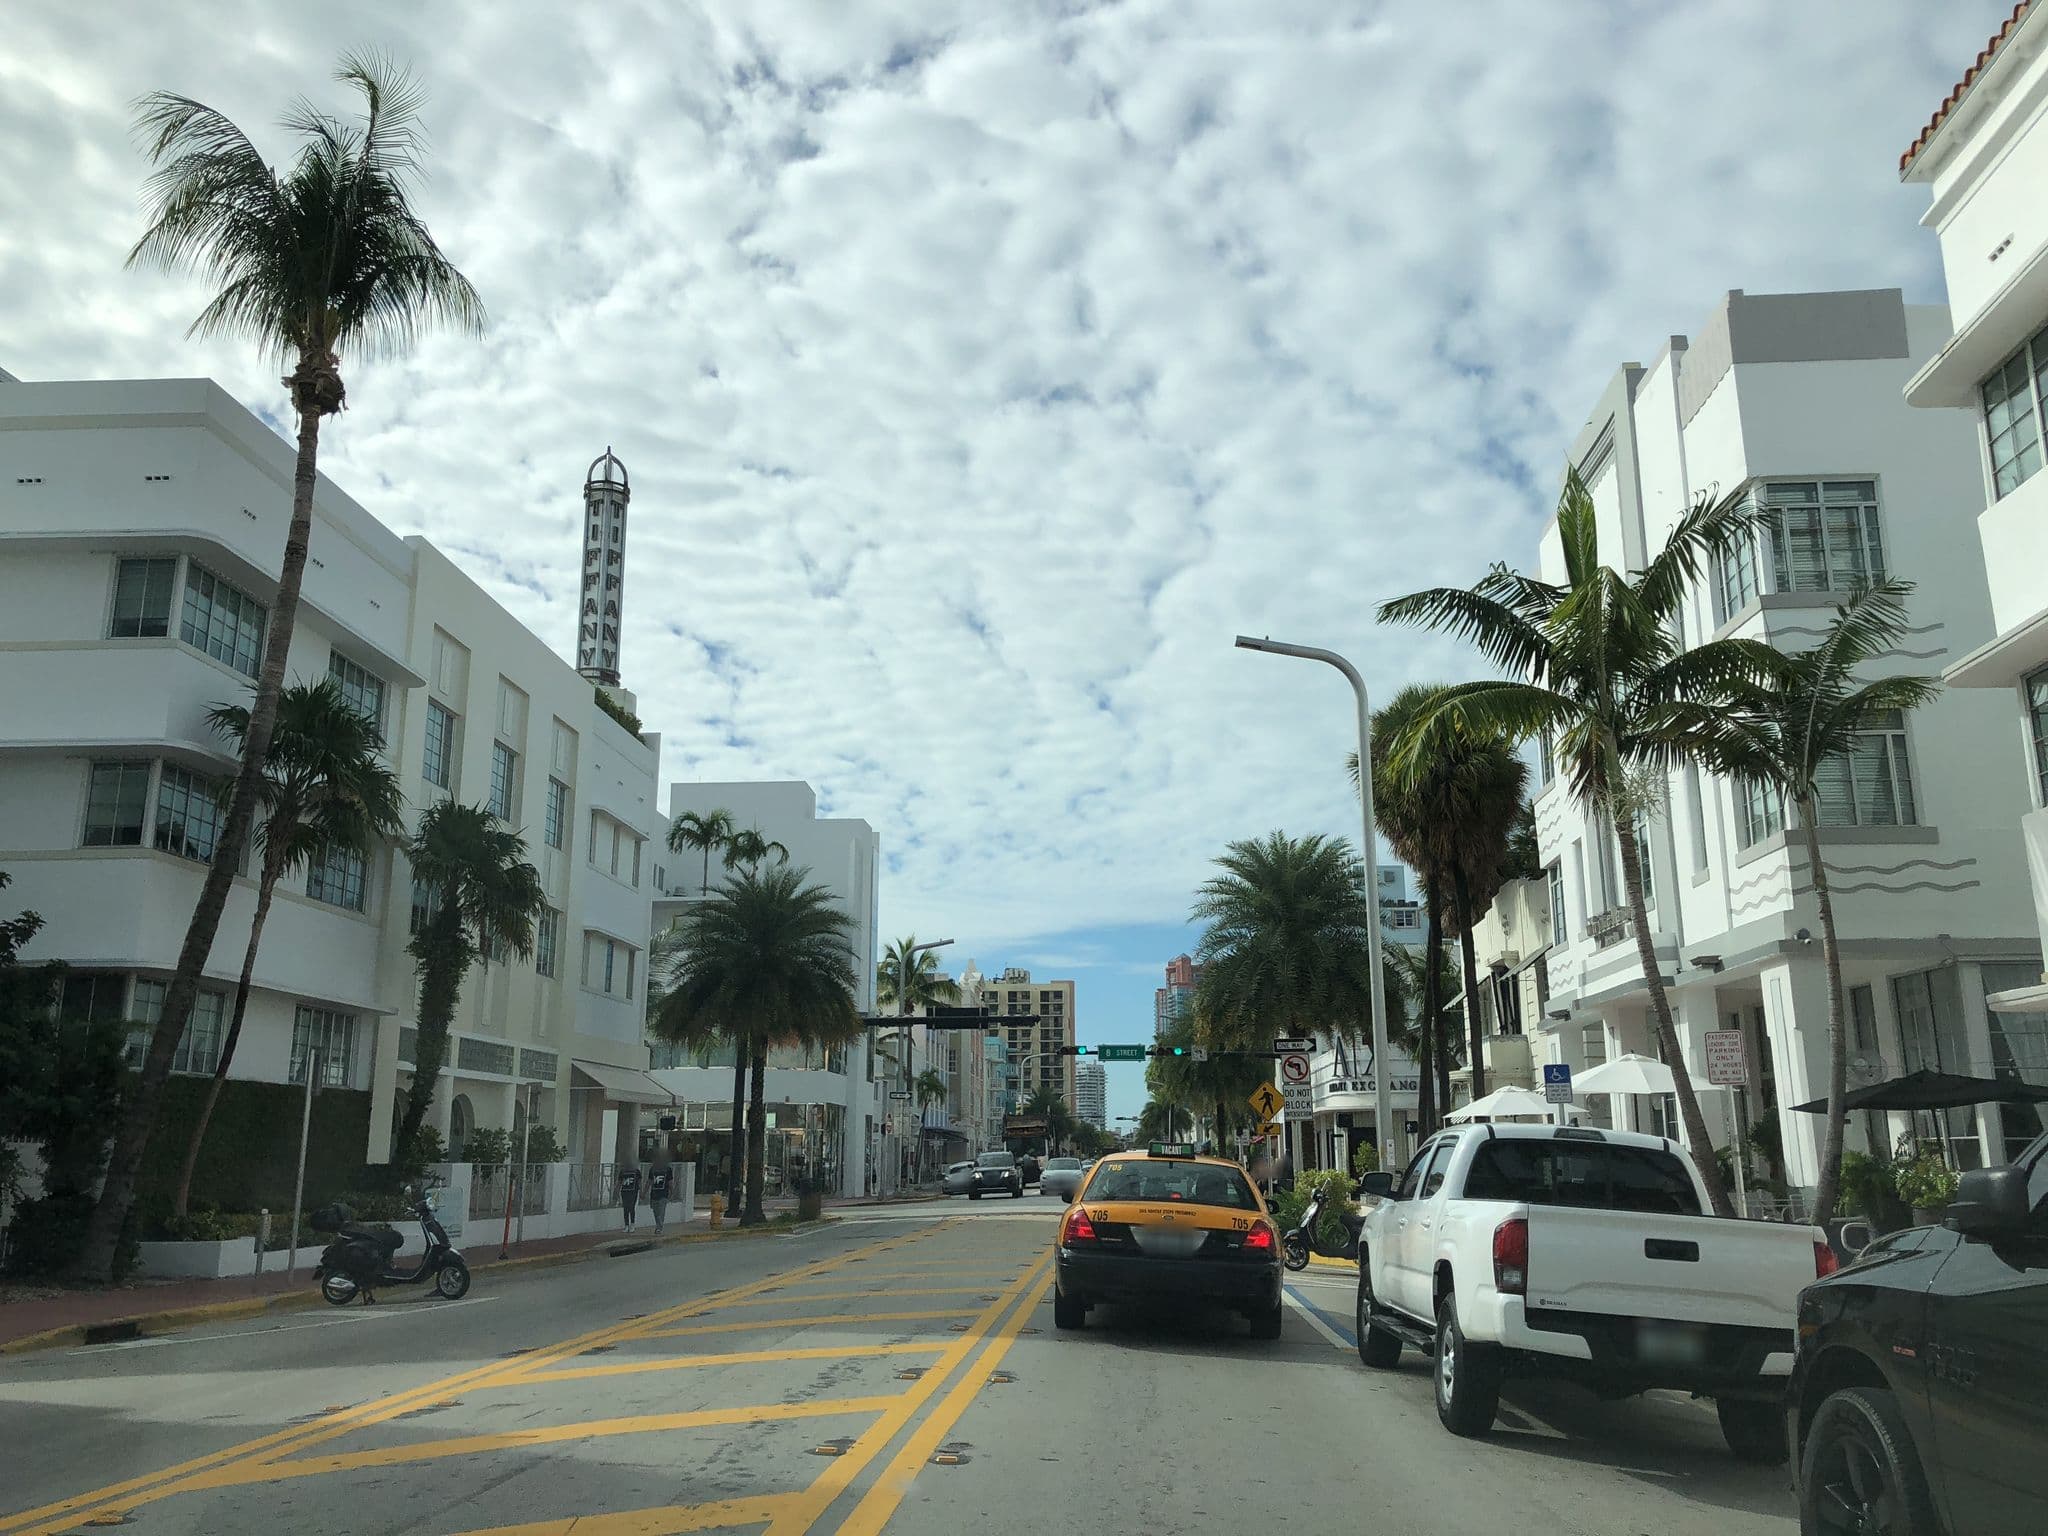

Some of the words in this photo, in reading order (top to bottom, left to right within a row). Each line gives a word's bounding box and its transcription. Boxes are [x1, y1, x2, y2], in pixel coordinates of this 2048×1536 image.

[582, 500, 603, 666] TIFFANY
[602, 500, 624, 668] TIFFANY
[1285, 1089, 1294, 1097] DO
[1297, 1089, 1311, 1097] NOT
[1286, 1100, 1311, 1109] BLOCK
[1092, 1210, 1108, 1221] 705
[1232, 1218, 1249, 1230] 705
